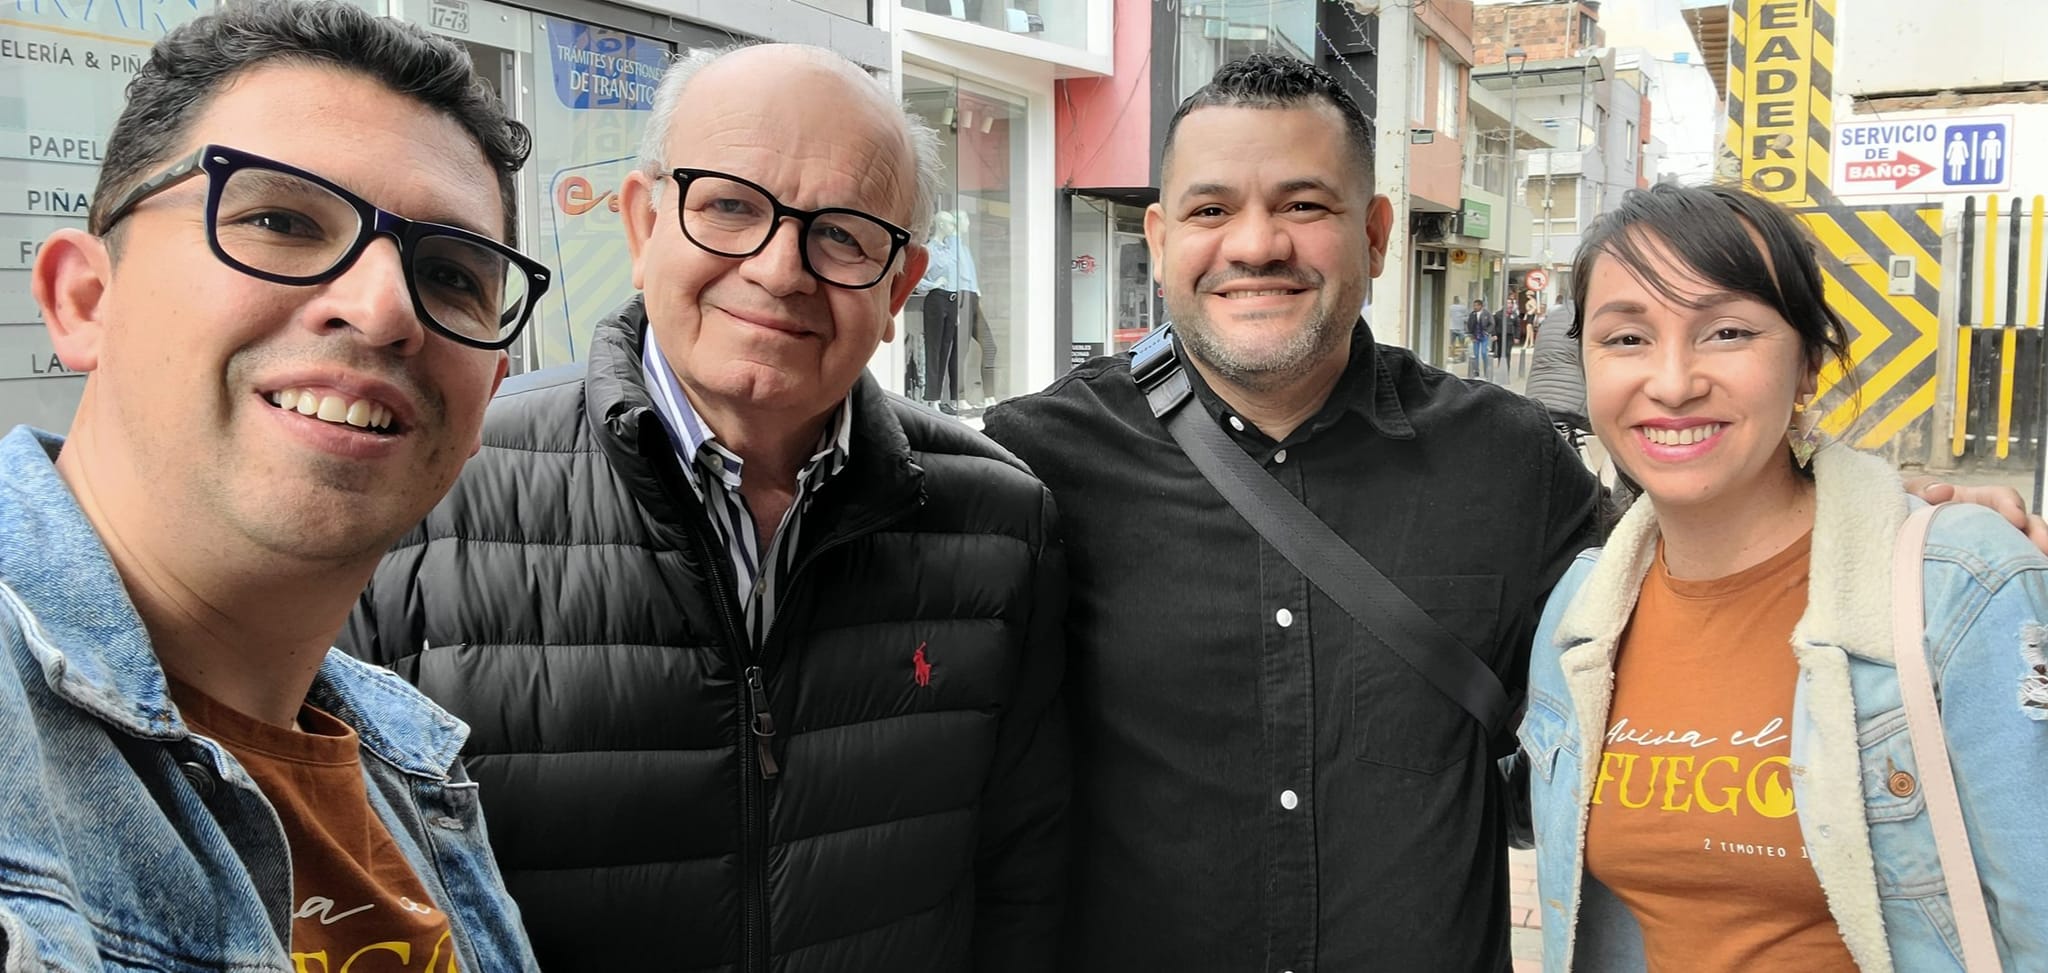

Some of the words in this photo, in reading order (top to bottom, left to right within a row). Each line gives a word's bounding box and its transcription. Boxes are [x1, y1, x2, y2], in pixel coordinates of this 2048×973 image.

[85, 51, 100, 69] &
[557, 44, 606, 69] TRÁMITES
[609, 57, 615, 69] Y
[570, 70, 589, 92] DE
[1841, 124, 1937, 146] SERVICIO
[1865, 147, 1889, 160] DE
[1849, 163, 1921, 179] BAÑOS
[1606, 718, 1717, 748] Aviva
[1730, 717, 1789, 748] el
[1591, 752, 1797, 818] FUEGO
[1704, 838, 1711, 850] 2
[1720, 842, 1787, 858] TIMOTEO
